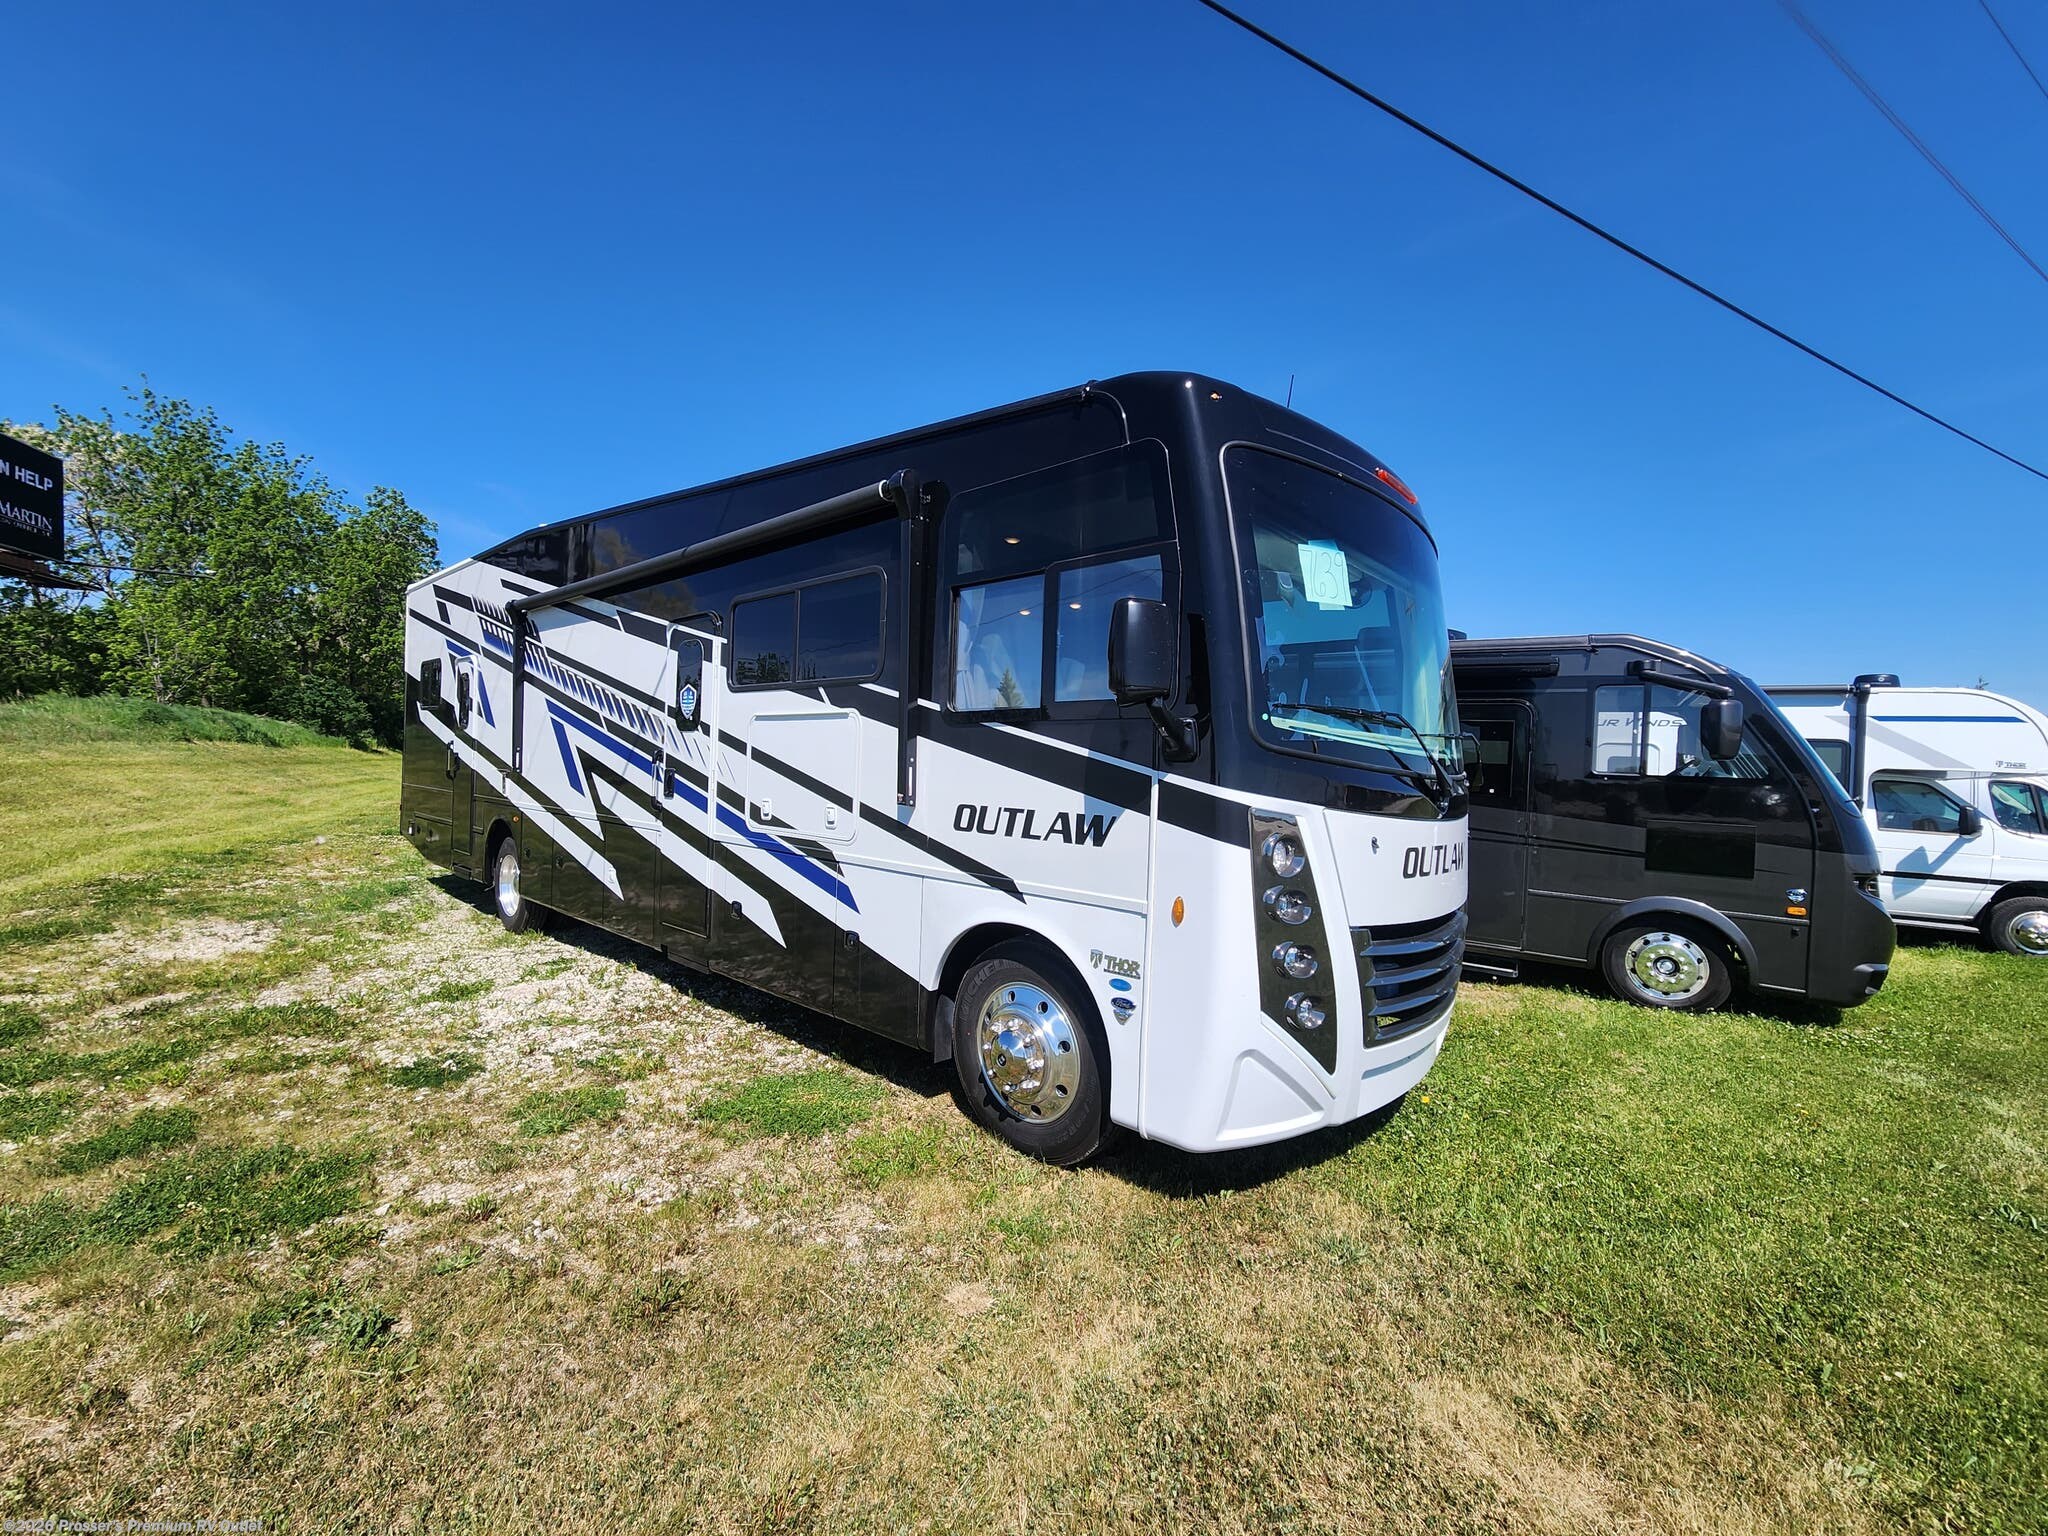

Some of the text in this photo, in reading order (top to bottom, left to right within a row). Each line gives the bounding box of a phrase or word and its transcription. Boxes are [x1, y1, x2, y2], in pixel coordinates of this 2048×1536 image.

[14, 465, 54, 491] HELP
[0, 500, 53, 533] MARTIN
[953, 803, 1117, 848] OUTLAW
[1104, 954, 1141, 977] THOR
